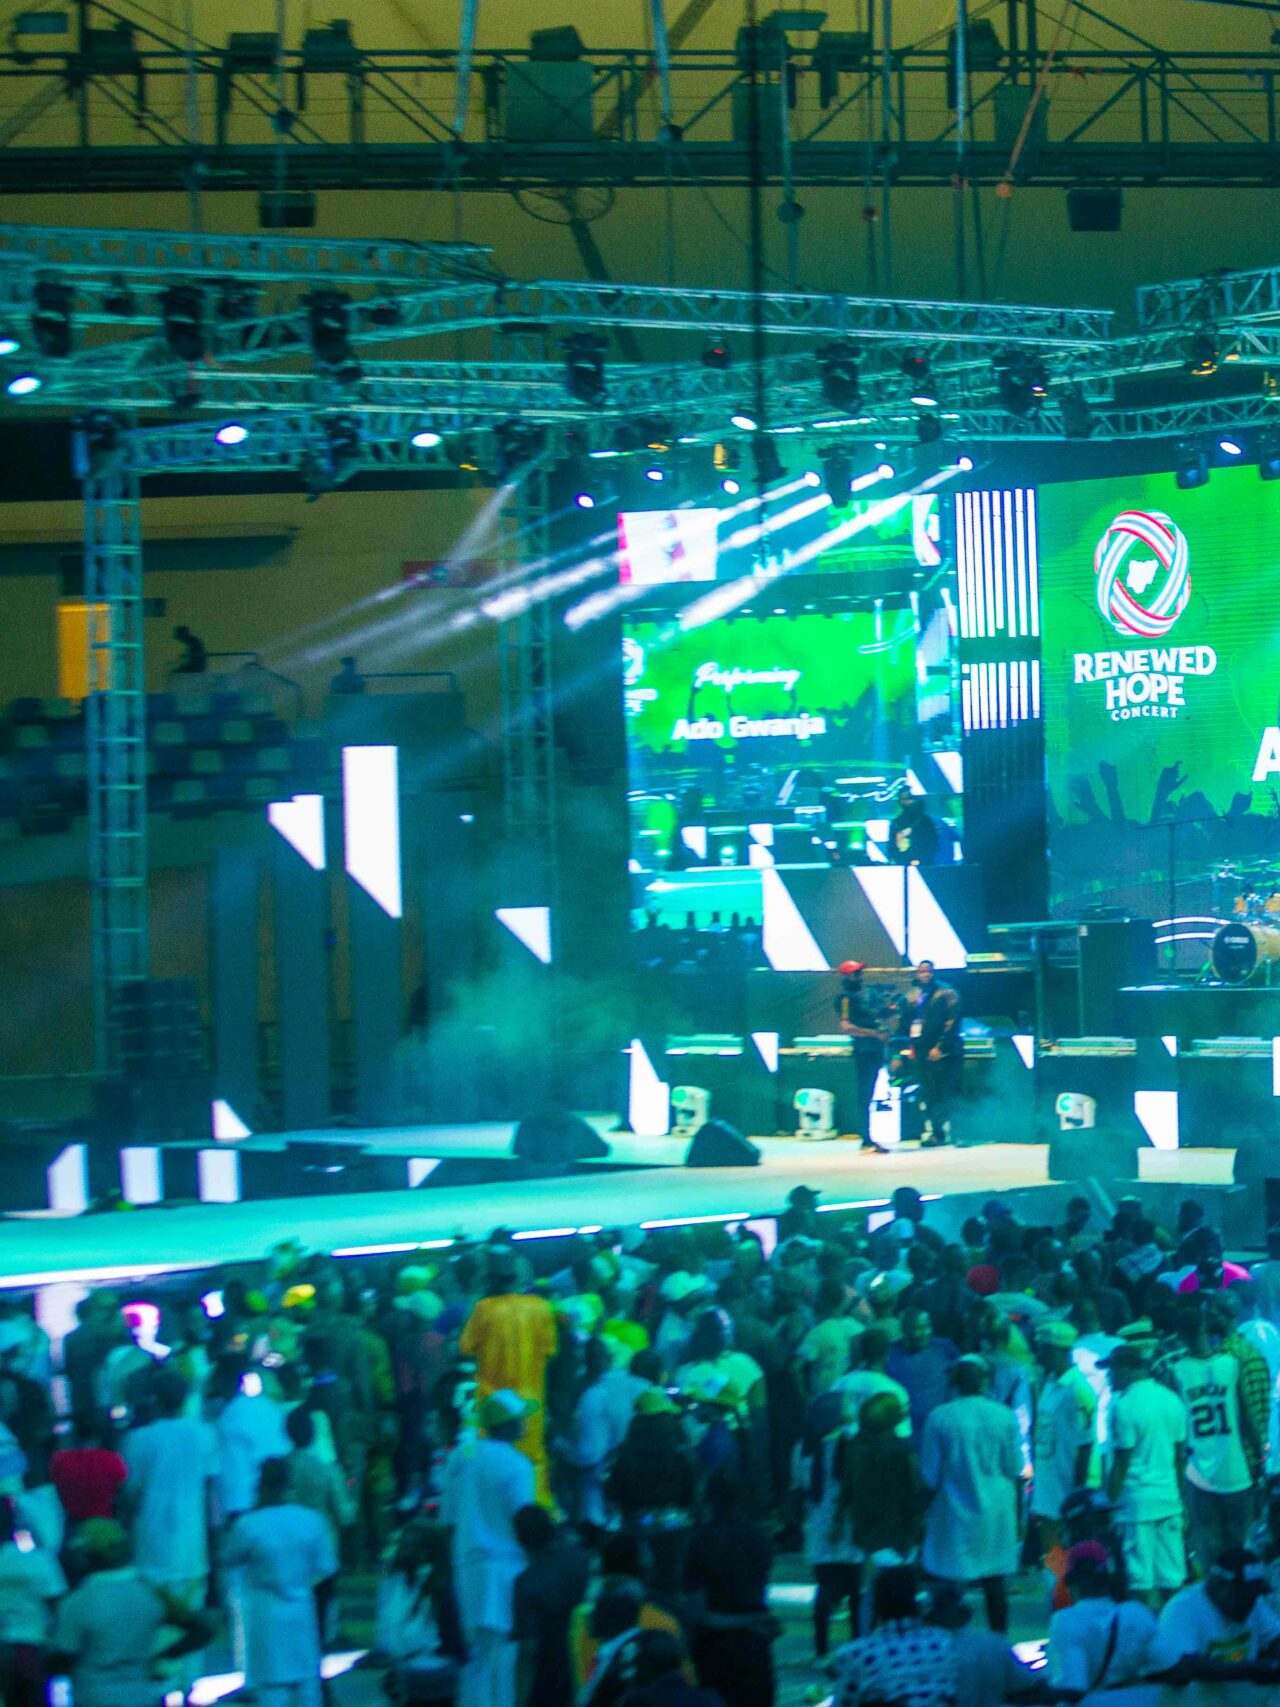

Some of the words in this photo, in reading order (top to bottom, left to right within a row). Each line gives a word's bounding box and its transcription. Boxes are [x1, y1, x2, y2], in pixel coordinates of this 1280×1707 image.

[1073, 645, 1218, 684] RENEWED
[1105, 672, 1186, 710] HOPE
[671, 717, 724, 740] Ado
[729, 712, 827, 740] Gwanja
[1110, 705, 1179, 721] CONCERT
[1192, 1404, 1232, 1438] 21
